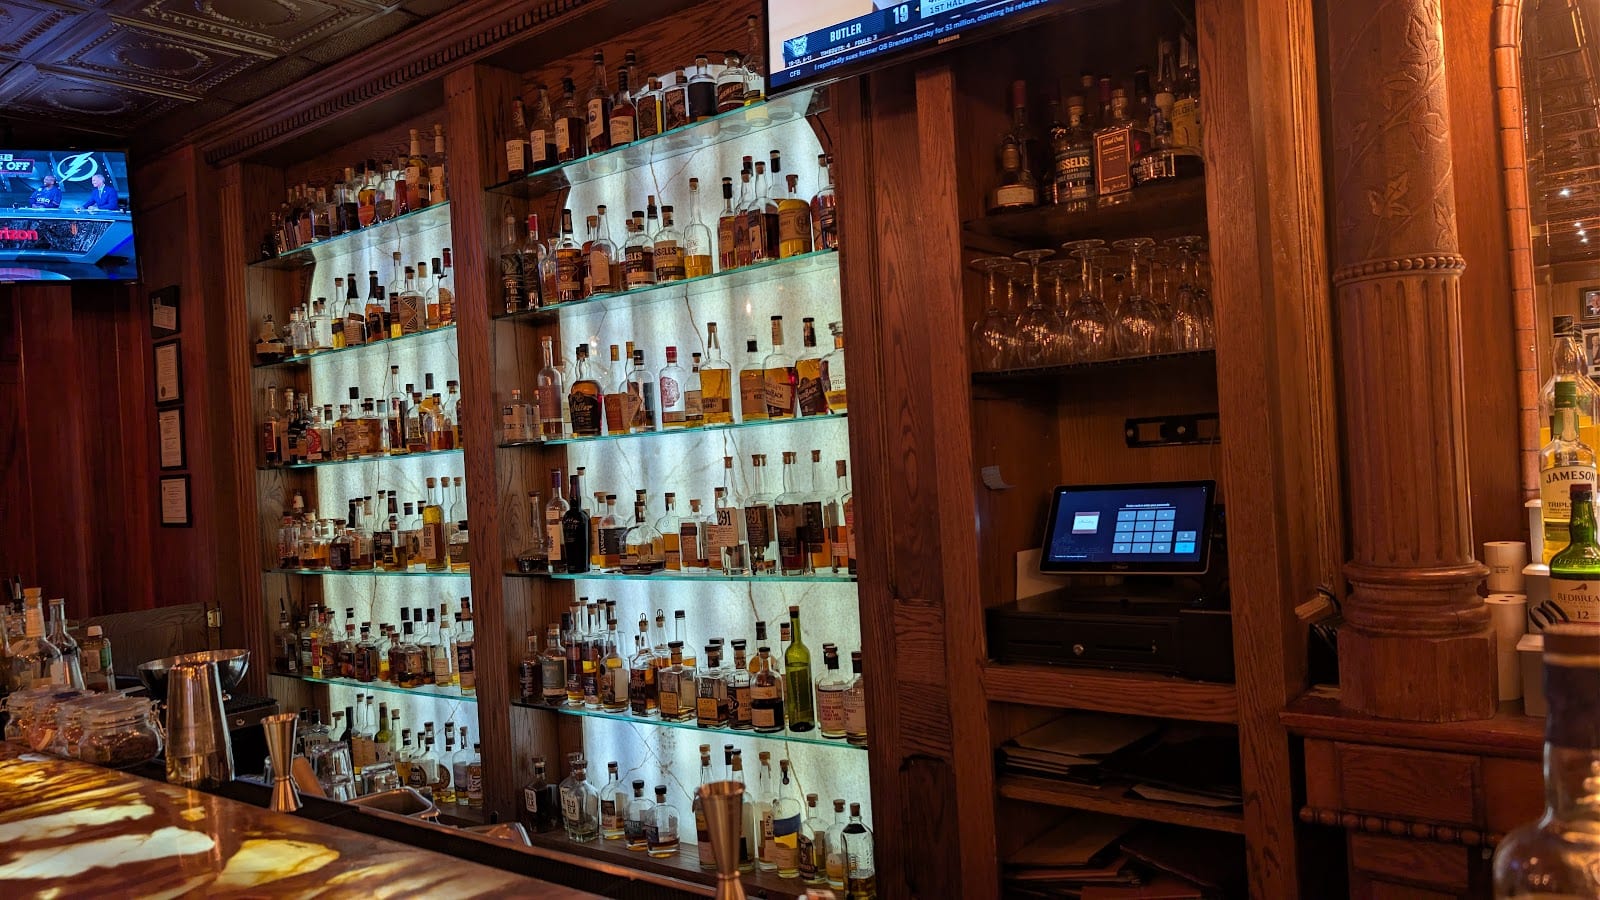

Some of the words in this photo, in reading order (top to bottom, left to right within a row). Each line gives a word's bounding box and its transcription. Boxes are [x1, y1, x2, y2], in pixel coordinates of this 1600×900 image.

[892, 4, 909, 25] 19
[930, 4, 945, 14] 1ST
[817, 55, 845, 70] reportedly
[845, 53, 858, 61] sues
[859, 46, 878, 57] former
[888, 36, 913, 50] Brendan
[913, 29, 934, 41] Sorsby
[935, 26, 944, 34] for
[945, 23, 953, 32] $1
[953, 16, 977, 28] million,
[977, 8, 1005, 22] claiming
[1005, 6, 1014, 14] he
[830, 22, 862, 42] BUTLER
[790, 70, 801, 78] CFB
[6, 162, 30, 171] OFF
[1546, 470, 1595, 484] JAMESON
[717, 510, 732, 526] 291
[1577, 610, 1590, 620] 12
